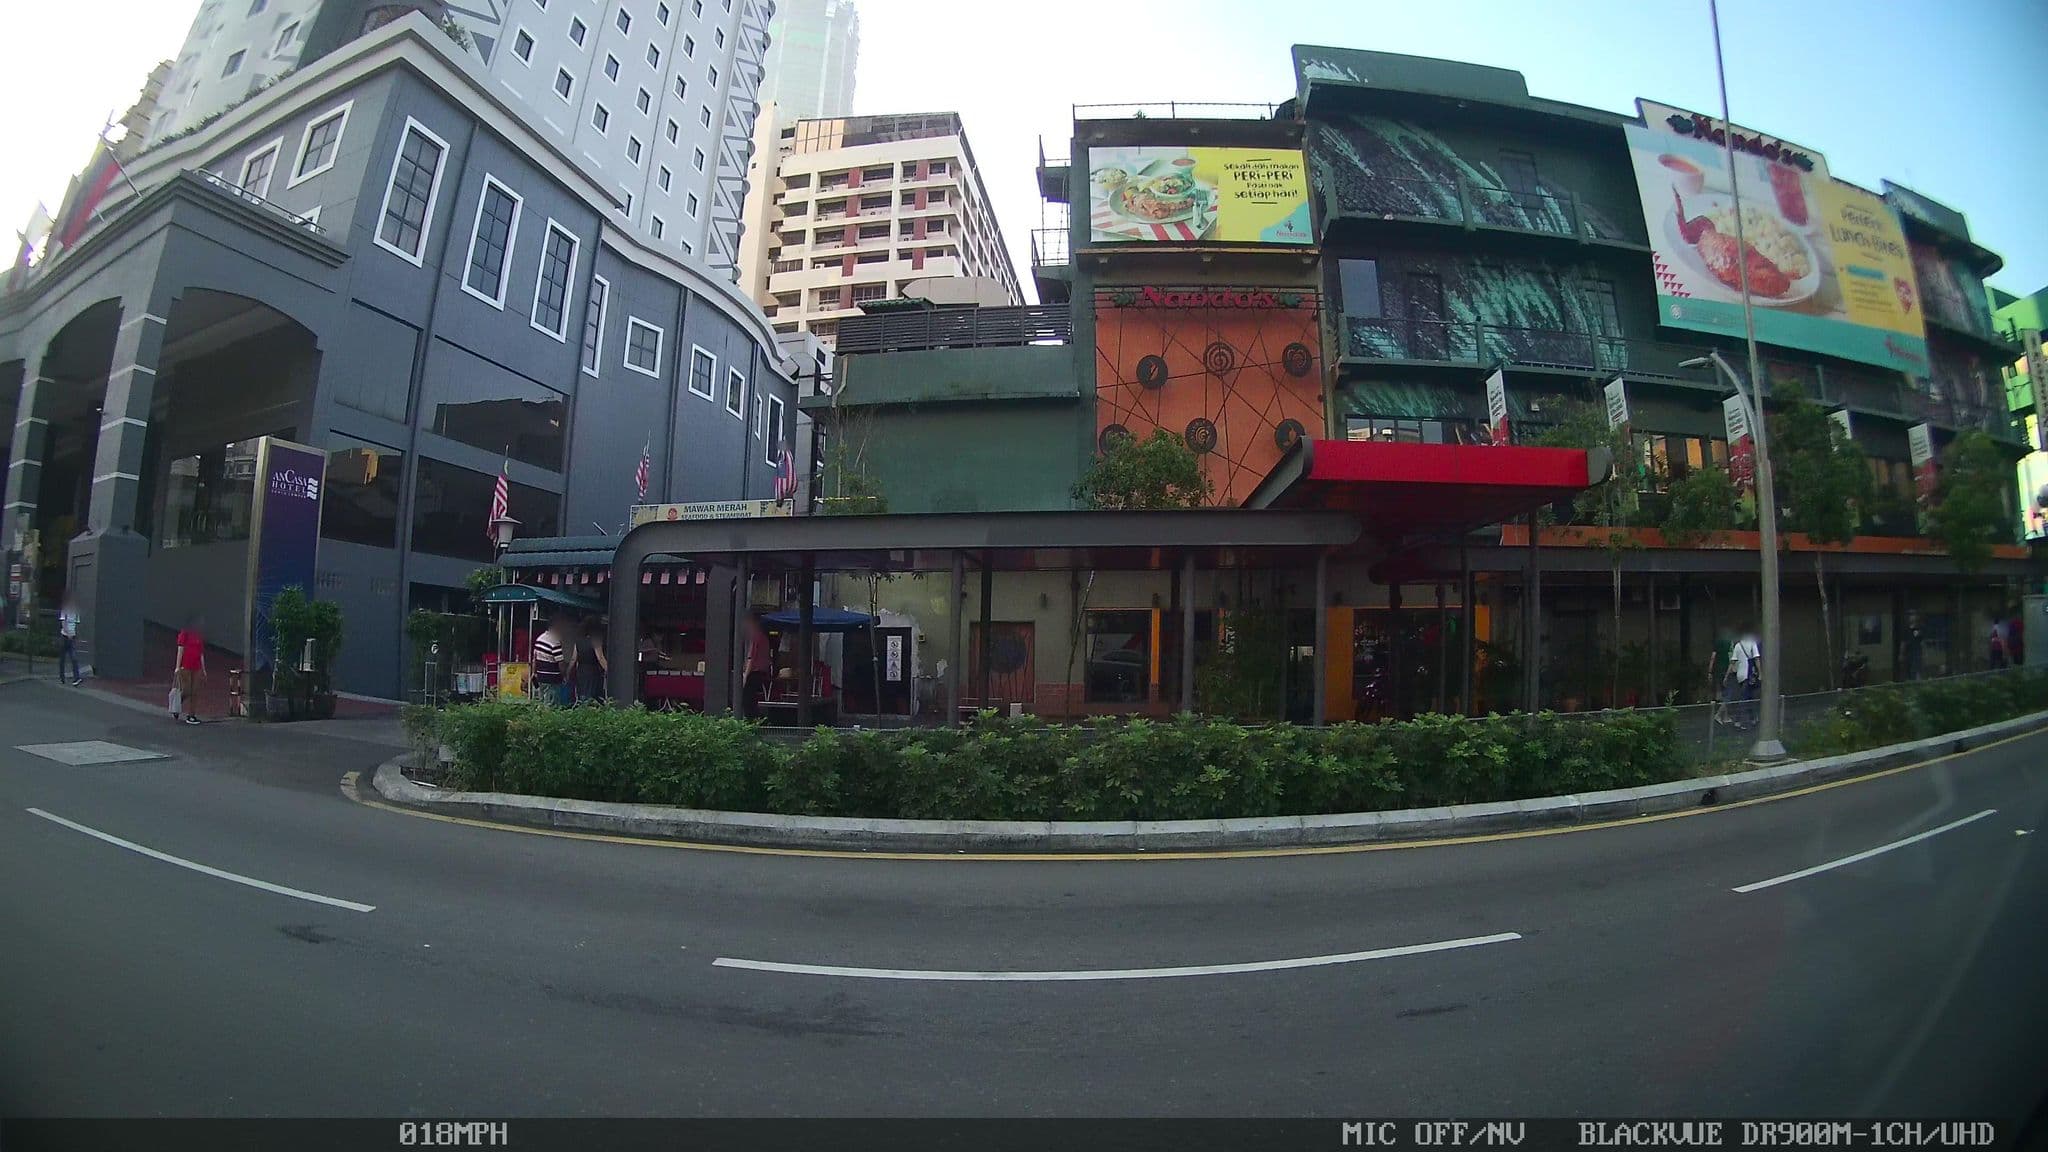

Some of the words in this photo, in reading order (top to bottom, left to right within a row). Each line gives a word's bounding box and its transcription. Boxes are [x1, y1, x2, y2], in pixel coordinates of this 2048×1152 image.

[1141, 286, 1276, 310] Nando's
[684, 504, 715, 513] MAWAR
[716, 503, 748, 512] MERAH
